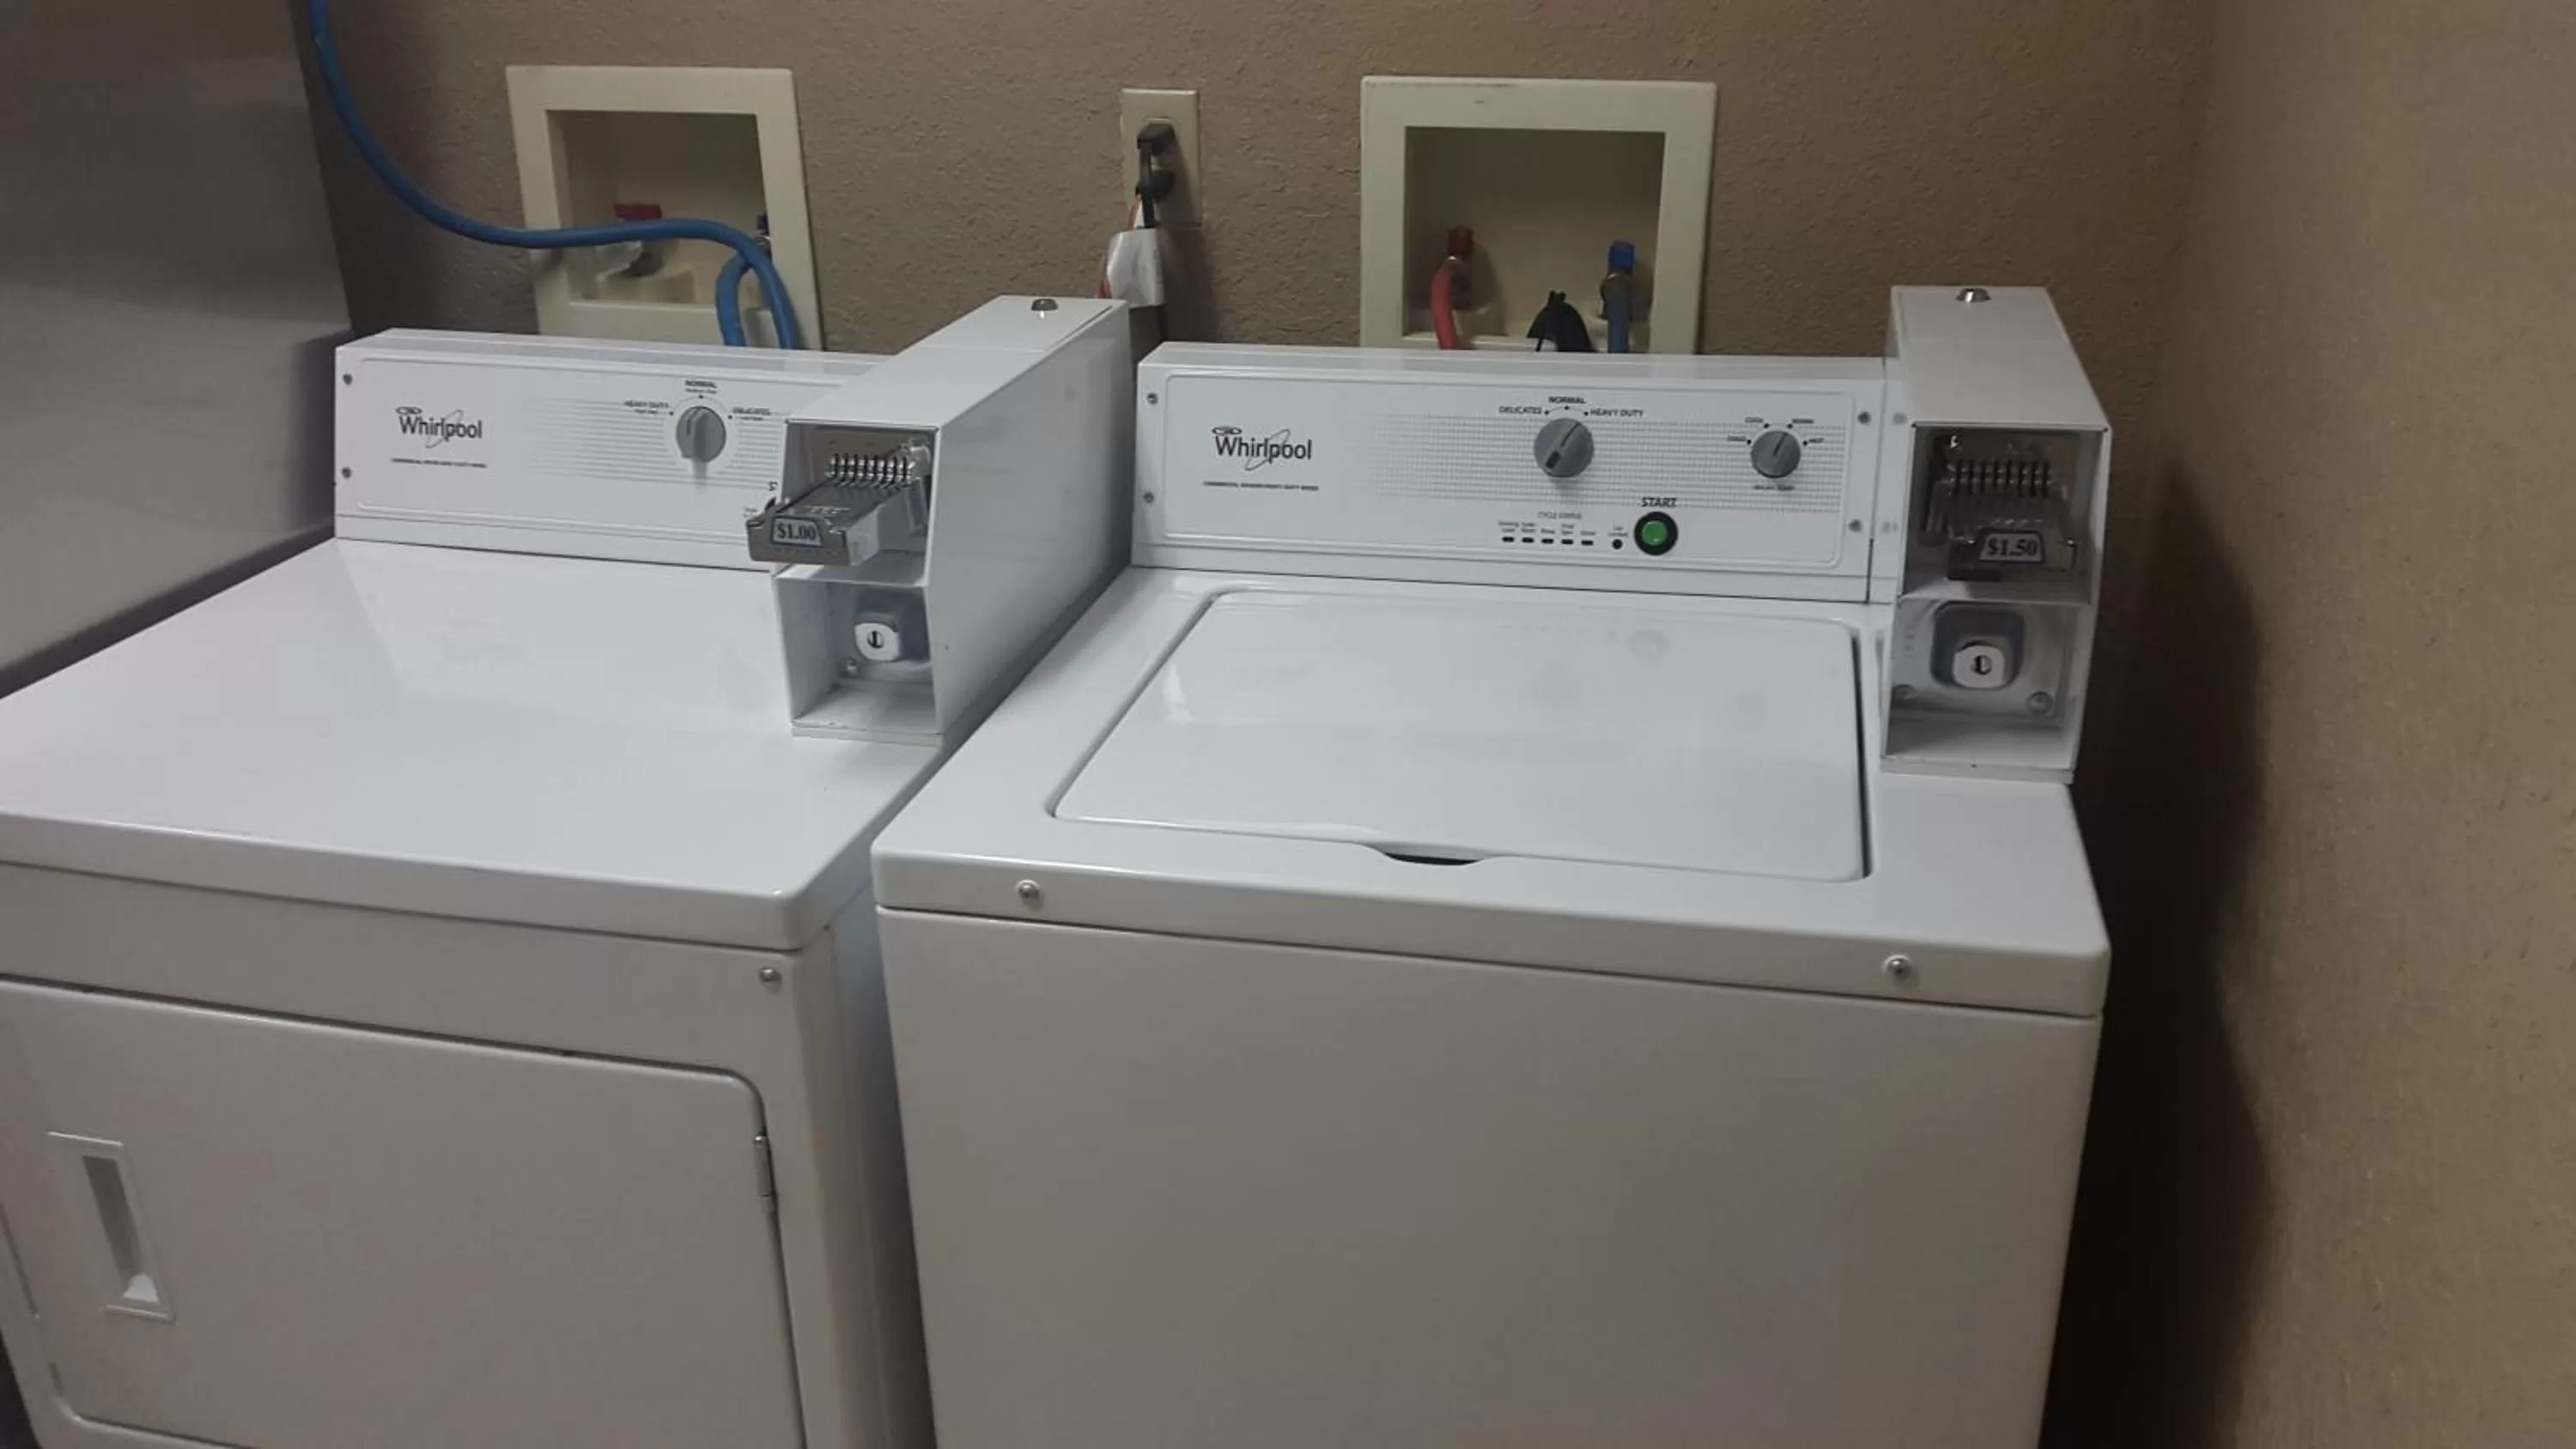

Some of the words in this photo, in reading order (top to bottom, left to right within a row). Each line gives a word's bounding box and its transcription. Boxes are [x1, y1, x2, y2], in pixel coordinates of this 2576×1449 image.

[1548, 396, 1587, 404] NORMAL
[398, 415, 483, 443] Whirlpool
[1214, 435, 1313, 464] Whirlpool
[1640, 497, 1677, 508] START
[776, 523, 817, 541] $1.00
[1988, 537, 2039, 557] $1.50
